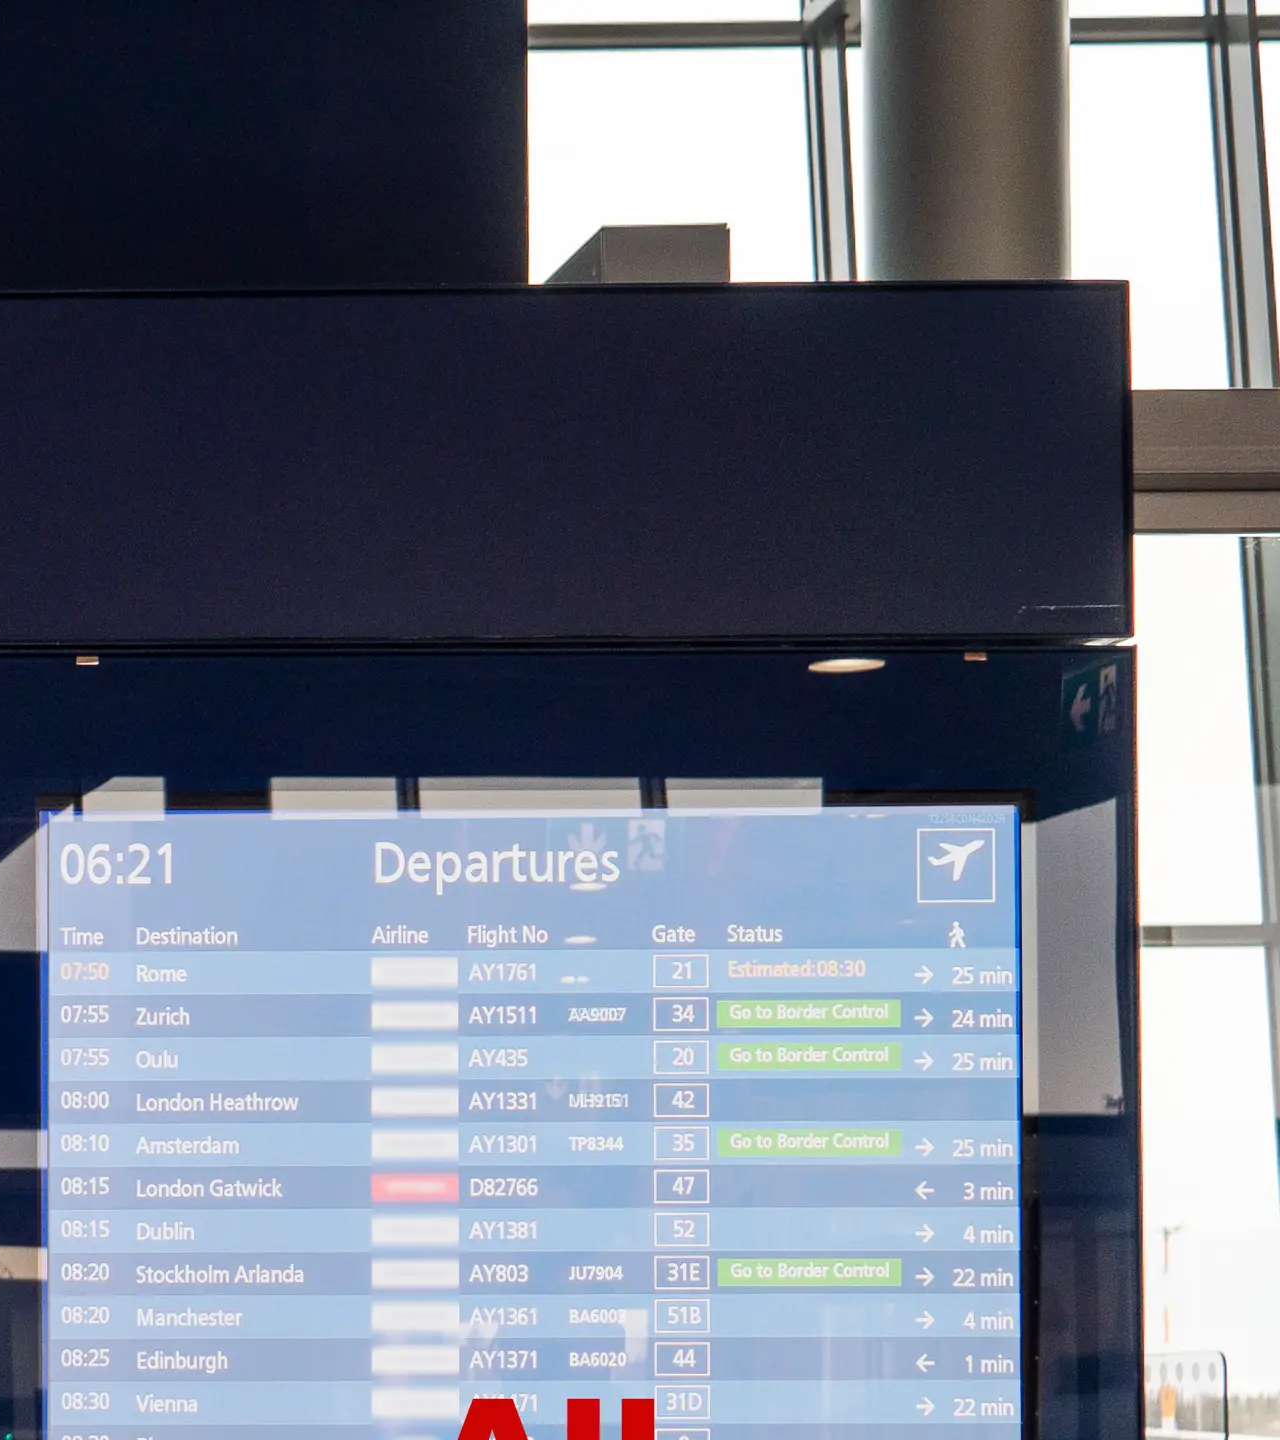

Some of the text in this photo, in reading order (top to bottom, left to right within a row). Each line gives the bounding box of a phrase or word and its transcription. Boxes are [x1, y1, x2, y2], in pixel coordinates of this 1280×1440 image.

[59, 842, 172, 885] 06:21
[374, 838, 621, 896] Departures
[58, 923, 783, 949] Time Destination Airline Flight No Gate Status
[60, 1348, 110, 1368] 08:25
[136, 1350, 228, 1375] Edinburgh
[469, 1350, 538, 1369] AY1371
[569, 1351, 628, 1367] BA6020
[672, 1348, 697, 1368] 44
[980, 1353, 1015, 1374] min
